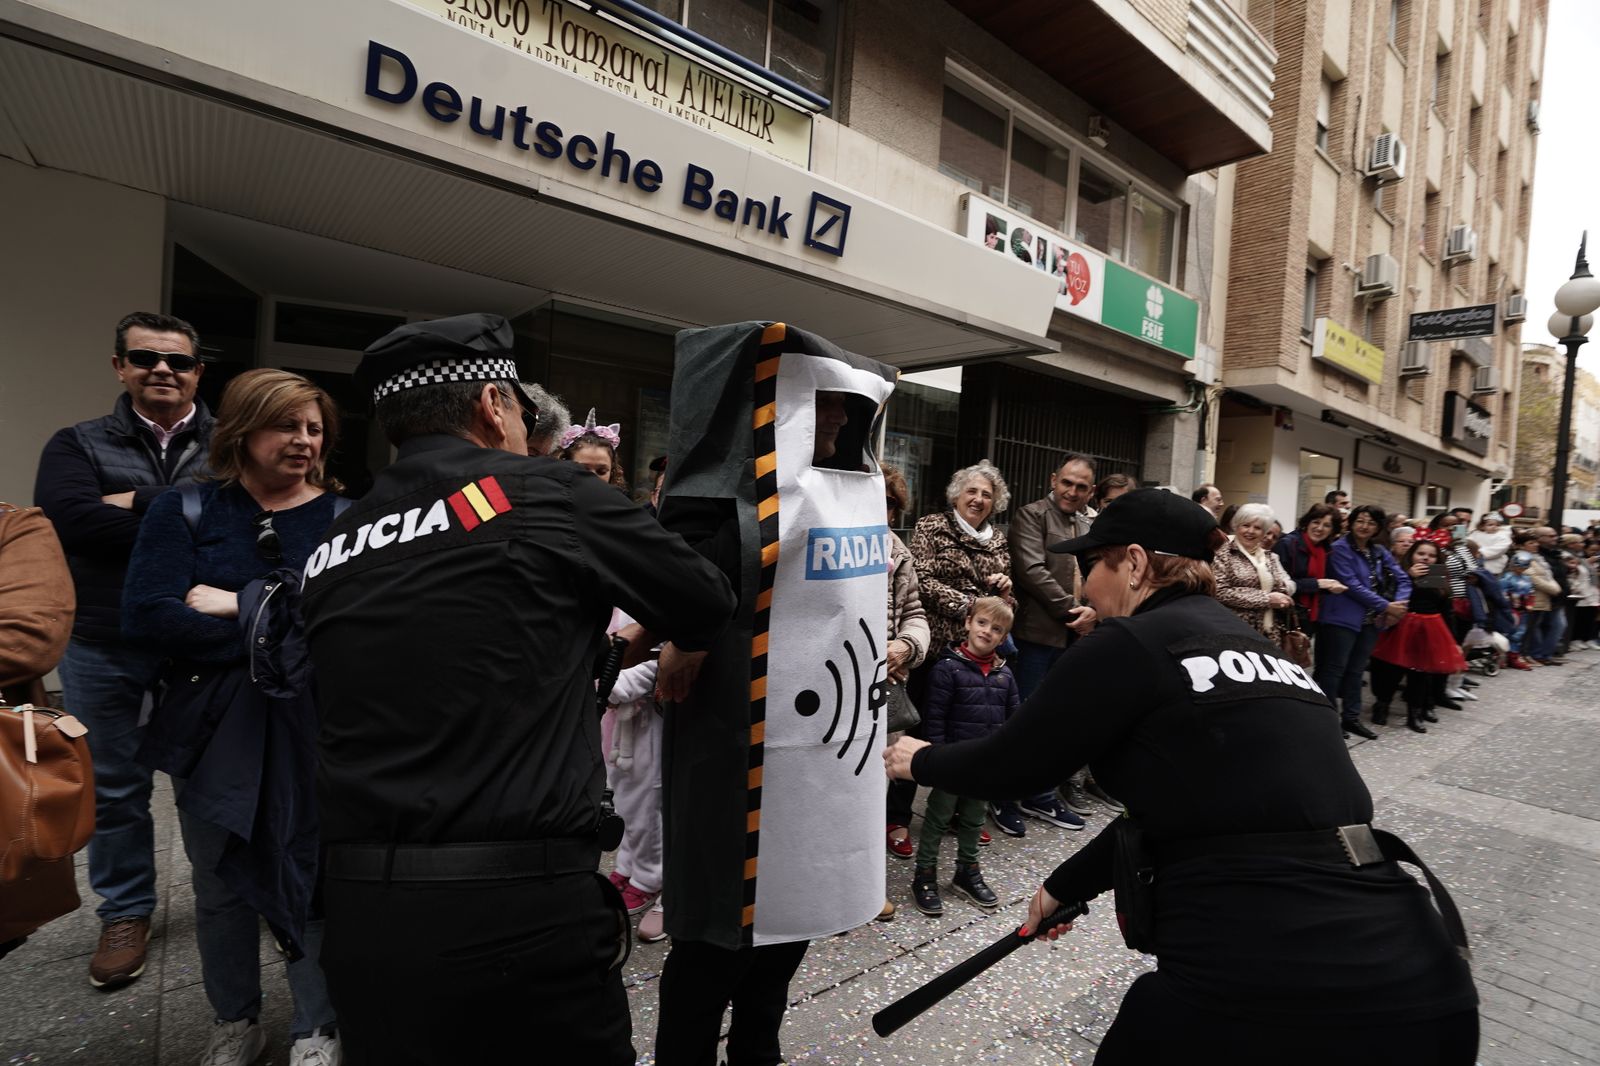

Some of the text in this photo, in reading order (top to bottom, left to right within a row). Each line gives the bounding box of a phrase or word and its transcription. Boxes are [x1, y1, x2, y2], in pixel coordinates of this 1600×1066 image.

[542, 1, 671, 99] Tamaral
[365, 39, 793, 239] Deutsche Bank
[1069, 274, 1087, 293] VOZ
[1070, 260, 1081, 275] TU
[1141, 319, 1164, 341] FSIE
[1181, 650, 1327, 697] POLICI
